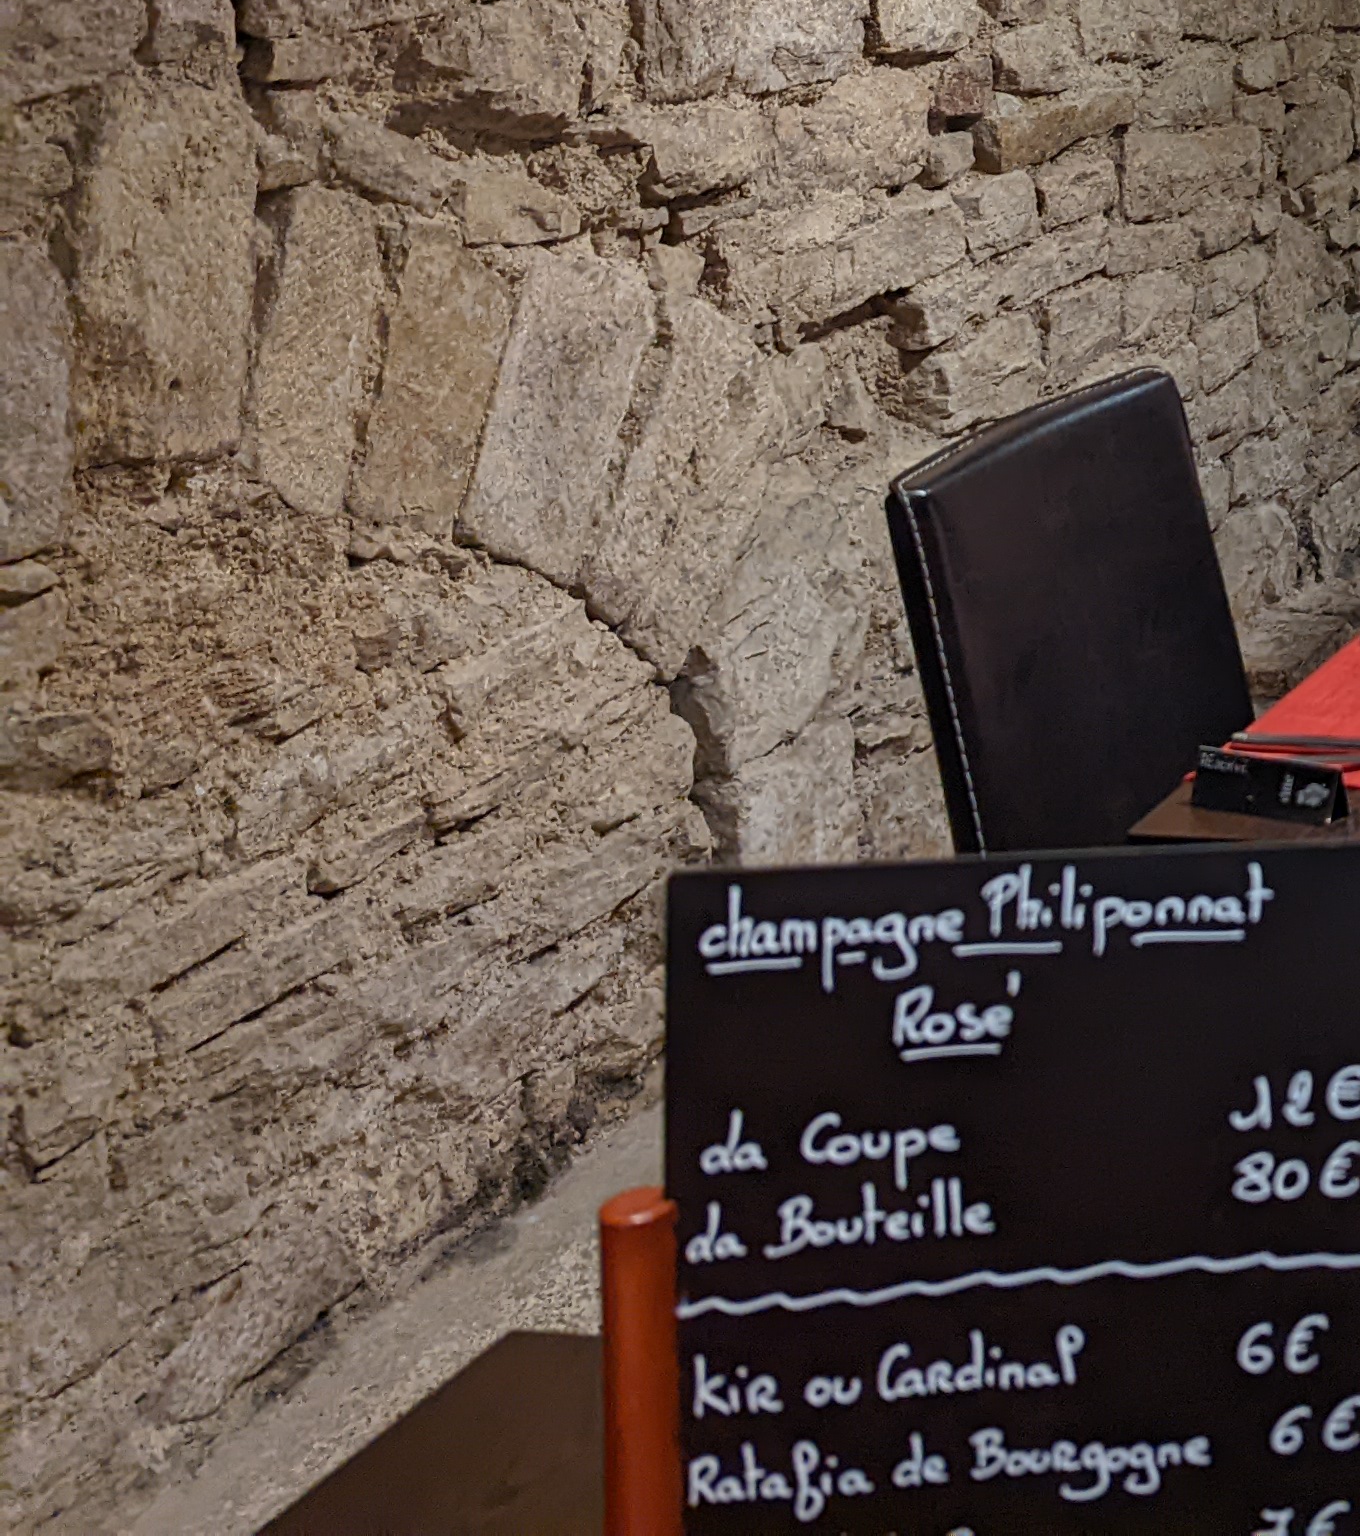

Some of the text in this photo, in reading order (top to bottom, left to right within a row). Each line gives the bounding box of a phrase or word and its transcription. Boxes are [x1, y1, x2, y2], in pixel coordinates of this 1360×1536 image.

[981, 862, 1275, 957] Philiponnat
[893, 970, 1021, 1047] Rosé
[800, 1112, 961, 1191] Coupe
[763, 1176, 996, 1259] Bouteille
[804, 1376, 862, 1408] ou
[877, 1324, 1085, 1402] Cardinal
[688, 1439, 875, 1522] Ratafia
[893, 1431, 950, 1488] de
[969, 1427, 1211, 1501] Bourgogne
